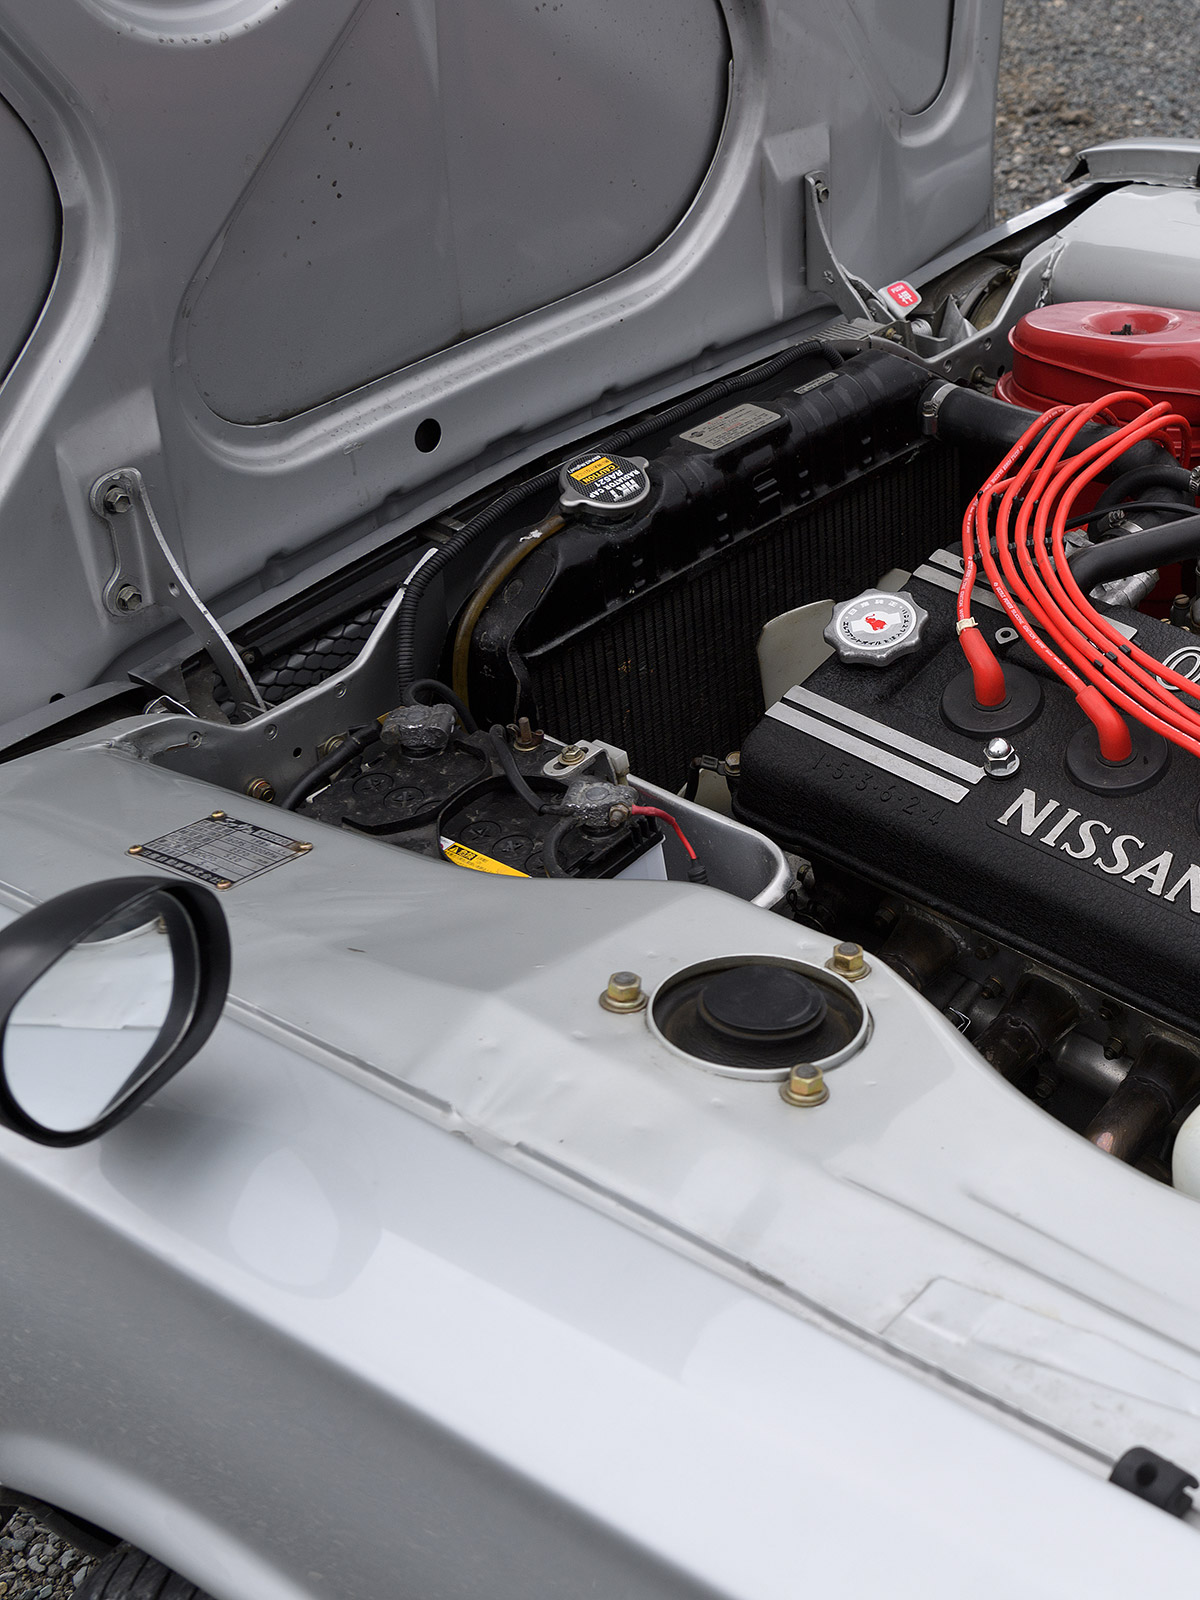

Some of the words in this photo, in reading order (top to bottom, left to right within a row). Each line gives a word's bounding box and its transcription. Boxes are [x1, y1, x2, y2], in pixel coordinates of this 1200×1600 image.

[582, 465, 615, 483] CAUTION
[594, 470, 623, 487] RA521
[603, 470, 640, 491] RADIATOR
[589, 488, 604, 498] CAP
[610, 479, 641, 502] HKT
[843, 621, 882, 645] エレファントオイル
